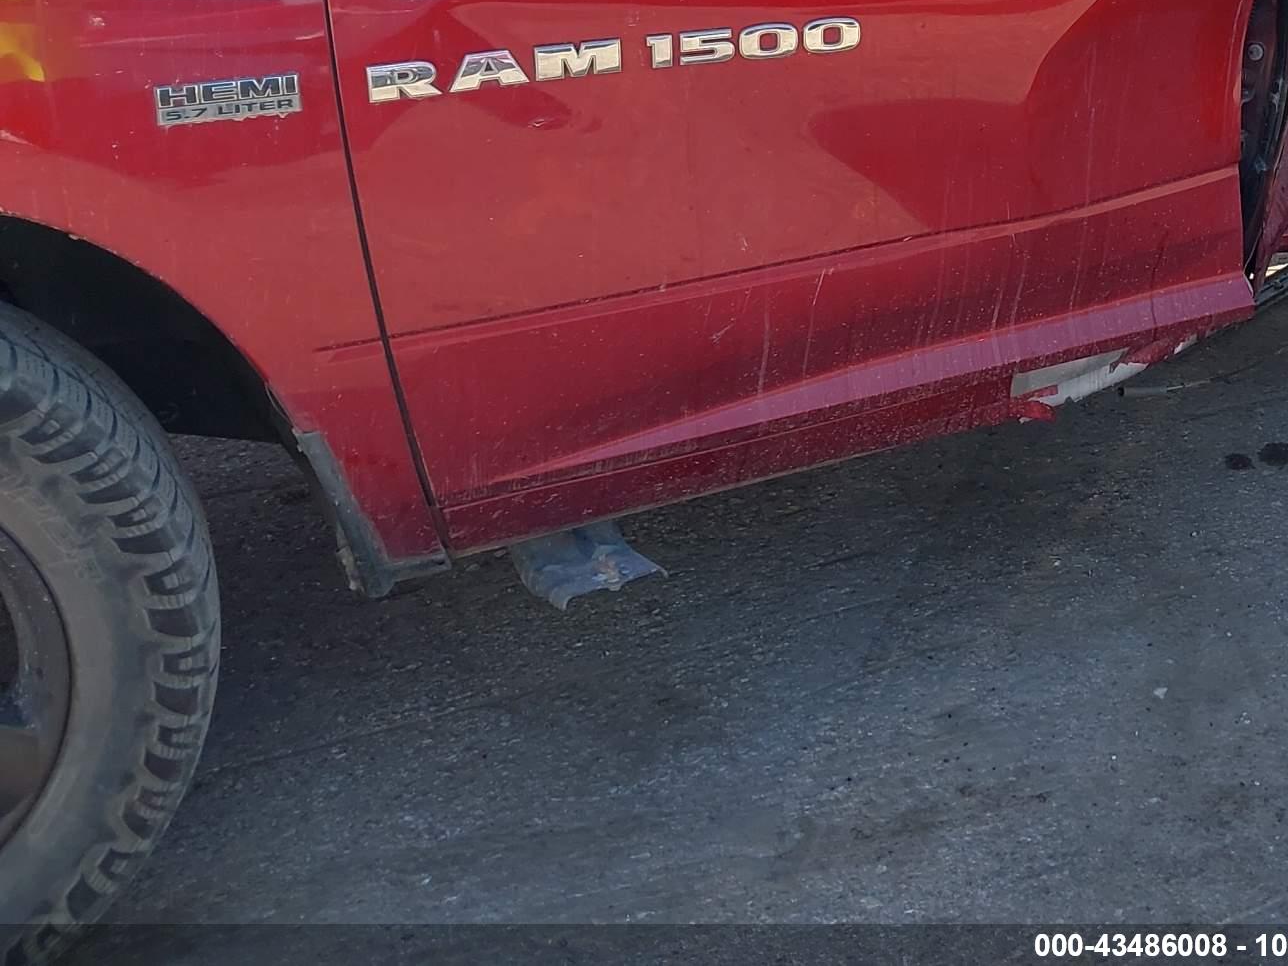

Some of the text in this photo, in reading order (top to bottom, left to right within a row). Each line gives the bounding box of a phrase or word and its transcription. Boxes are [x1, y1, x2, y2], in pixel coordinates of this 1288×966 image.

[367, 16, 861, 103] RAM 1500
[156, 74, 299, 109] HEMI
[165, 98, 294, 122] 5.7 LITER
